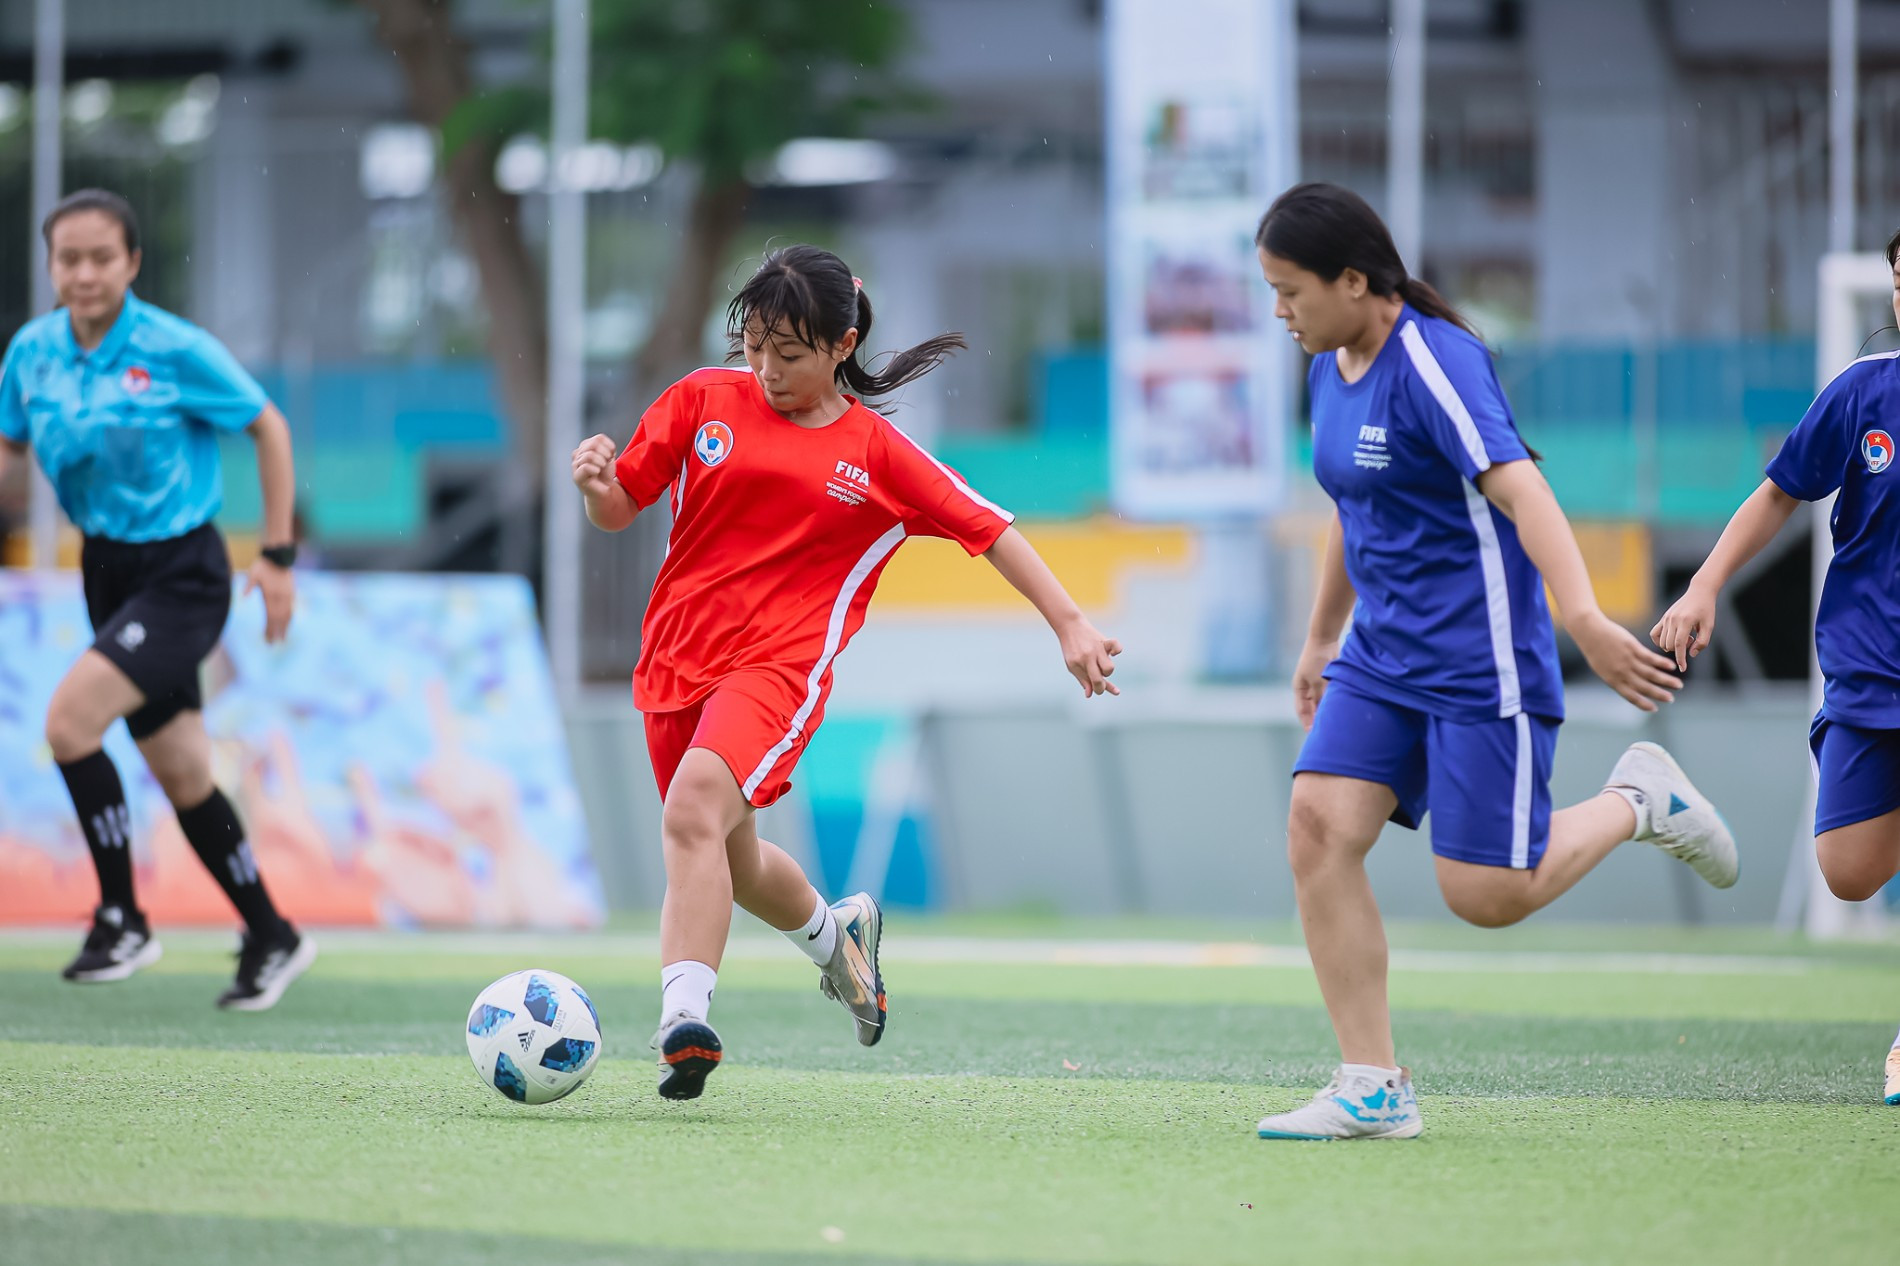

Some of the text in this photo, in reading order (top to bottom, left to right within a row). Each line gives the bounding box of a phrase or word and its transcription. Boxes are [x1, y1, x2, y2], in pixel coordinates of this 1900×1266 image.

[1358, 424, 1387, 444] FIFA
[834, 459, 870, 487] FIFA
[523, 1029, 536, 1053] adidas
